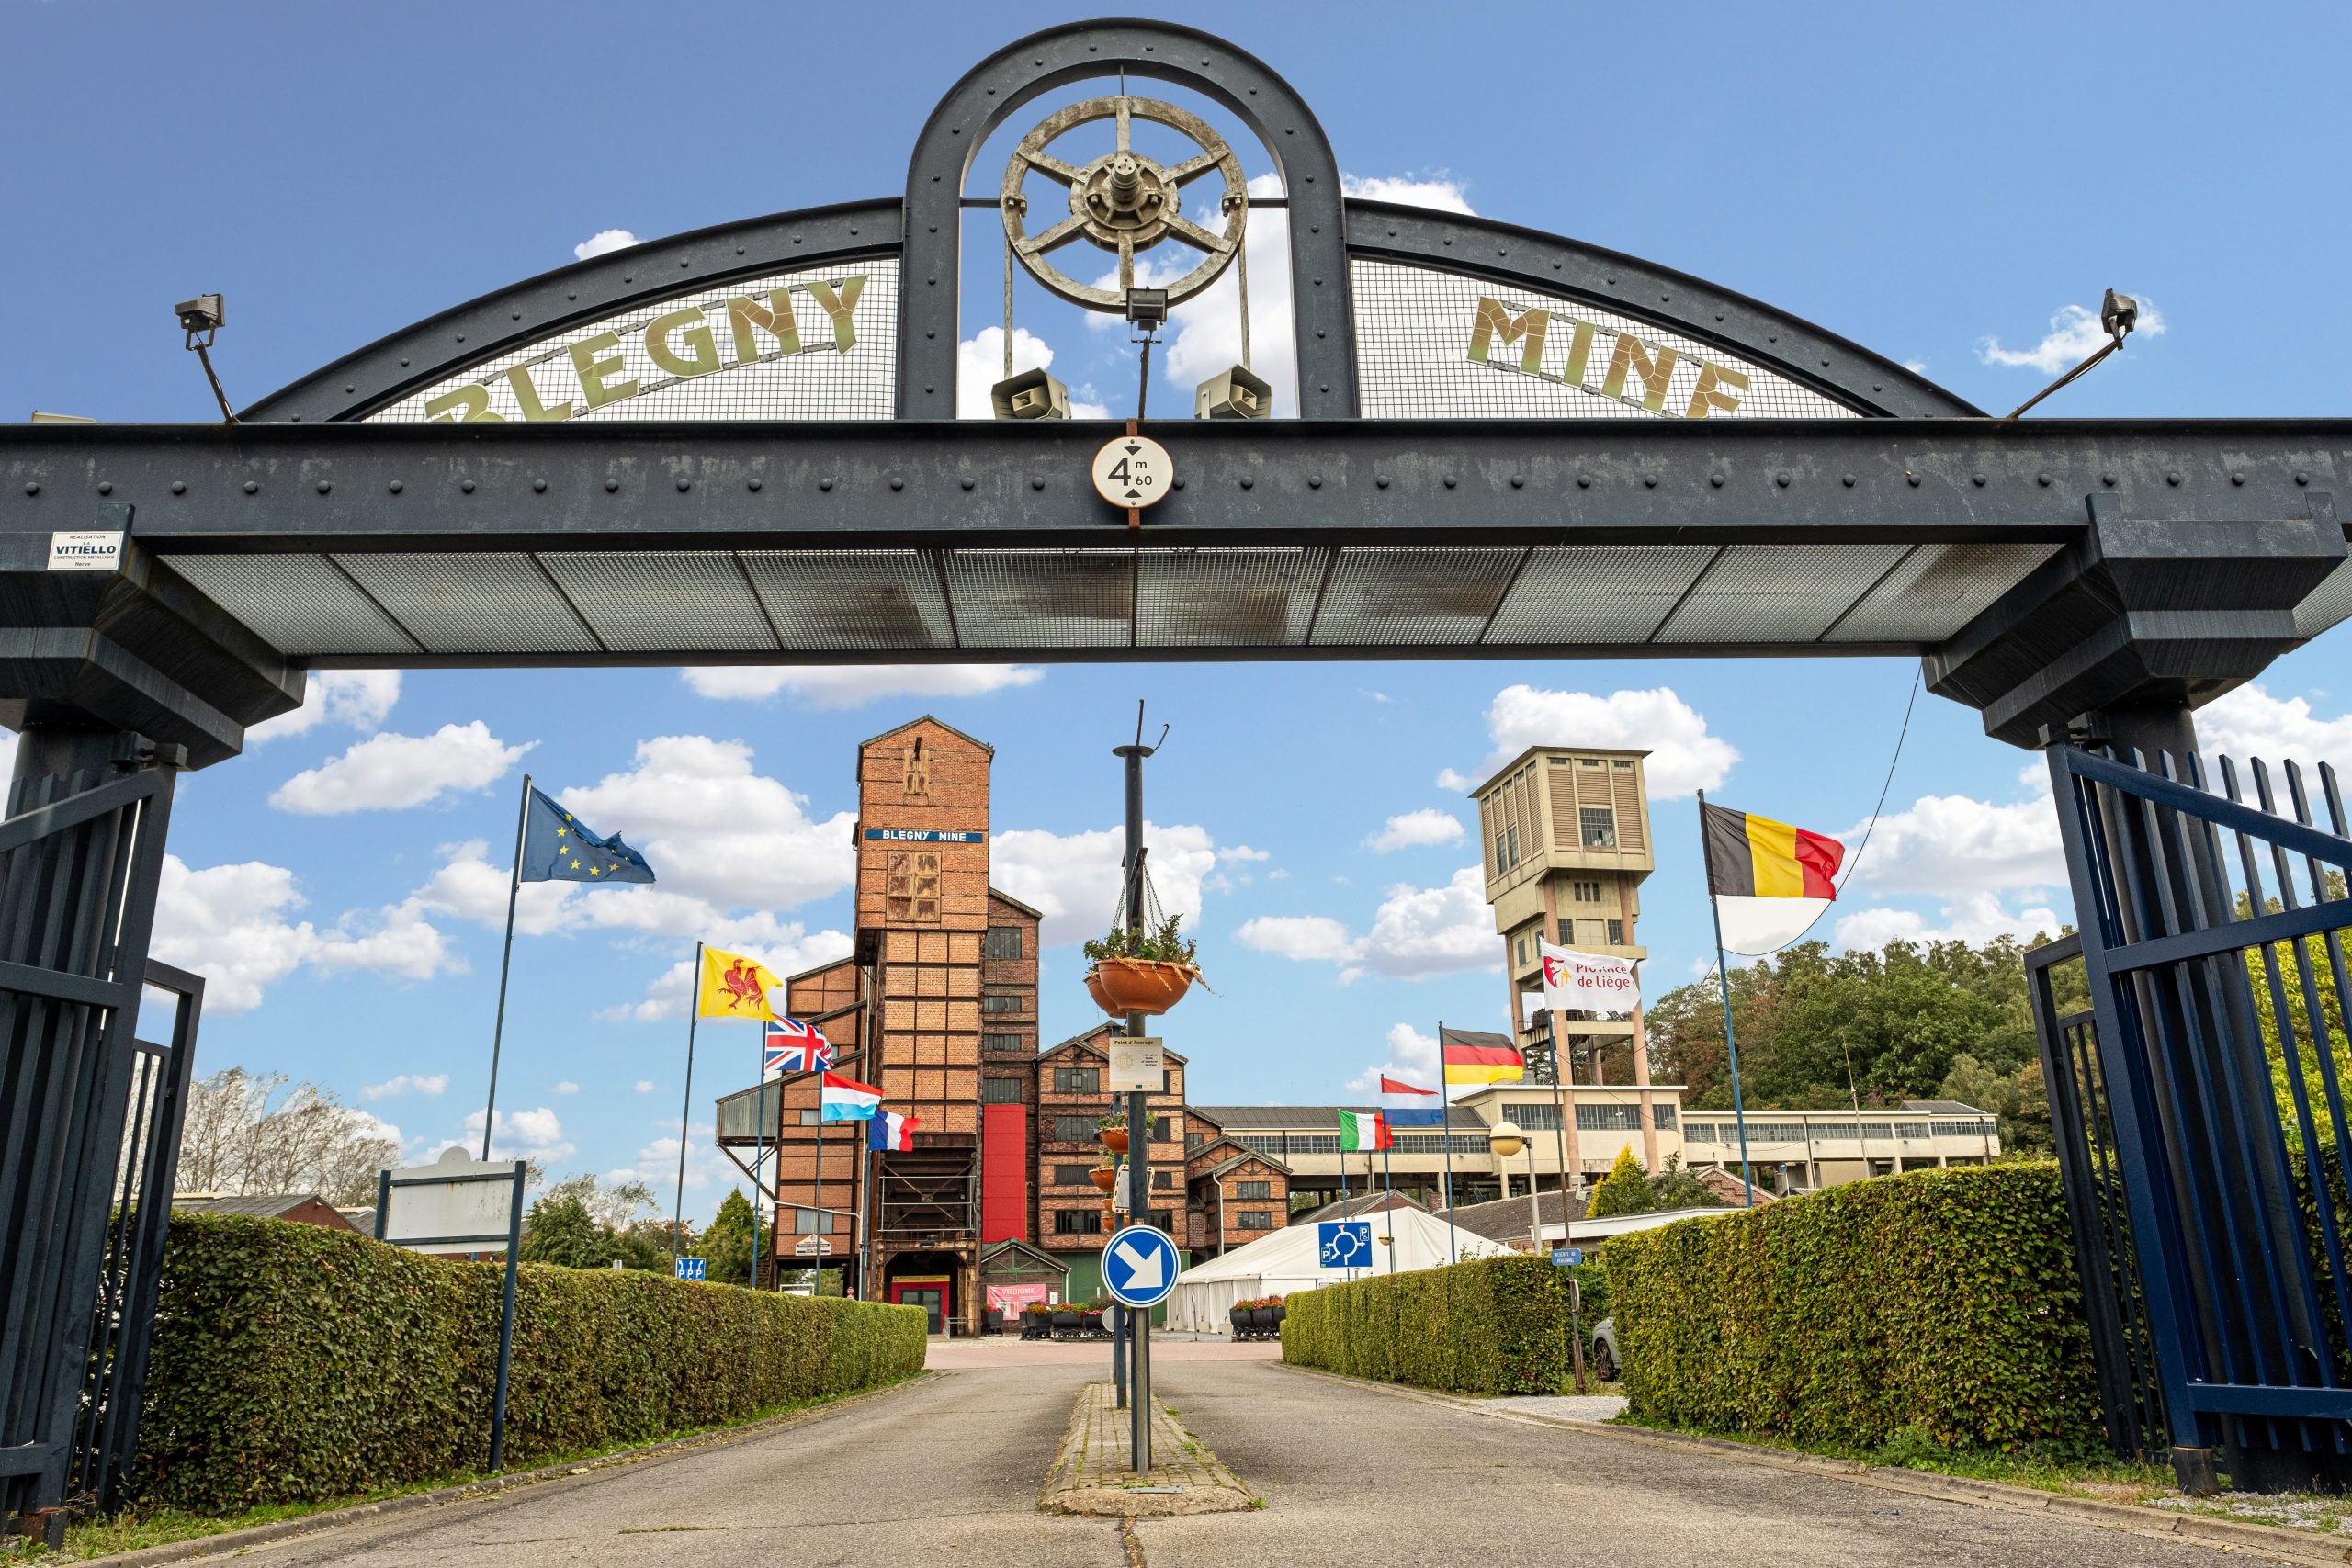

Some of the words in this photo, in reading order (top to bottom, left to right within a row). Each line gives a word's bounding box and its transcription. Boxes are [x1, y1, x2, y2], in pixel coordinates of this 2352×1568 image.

[424, 275, 869, 422] BLEGNY
[1108, 457, 1131, 486] 4
[1136, 475, 1153, 486] 60
[56, 545, 117, 555] VITIELLO
[882, 829, 930, 840] BLEGNY
[939, 832, 967, 842] MINE
[1577, 976, 1592, 987] de
[1596, 976, 1630, 991] Liège
[1361, 1227, 1367, 1237] P
[1323, 1250, 1329, 1259] P
